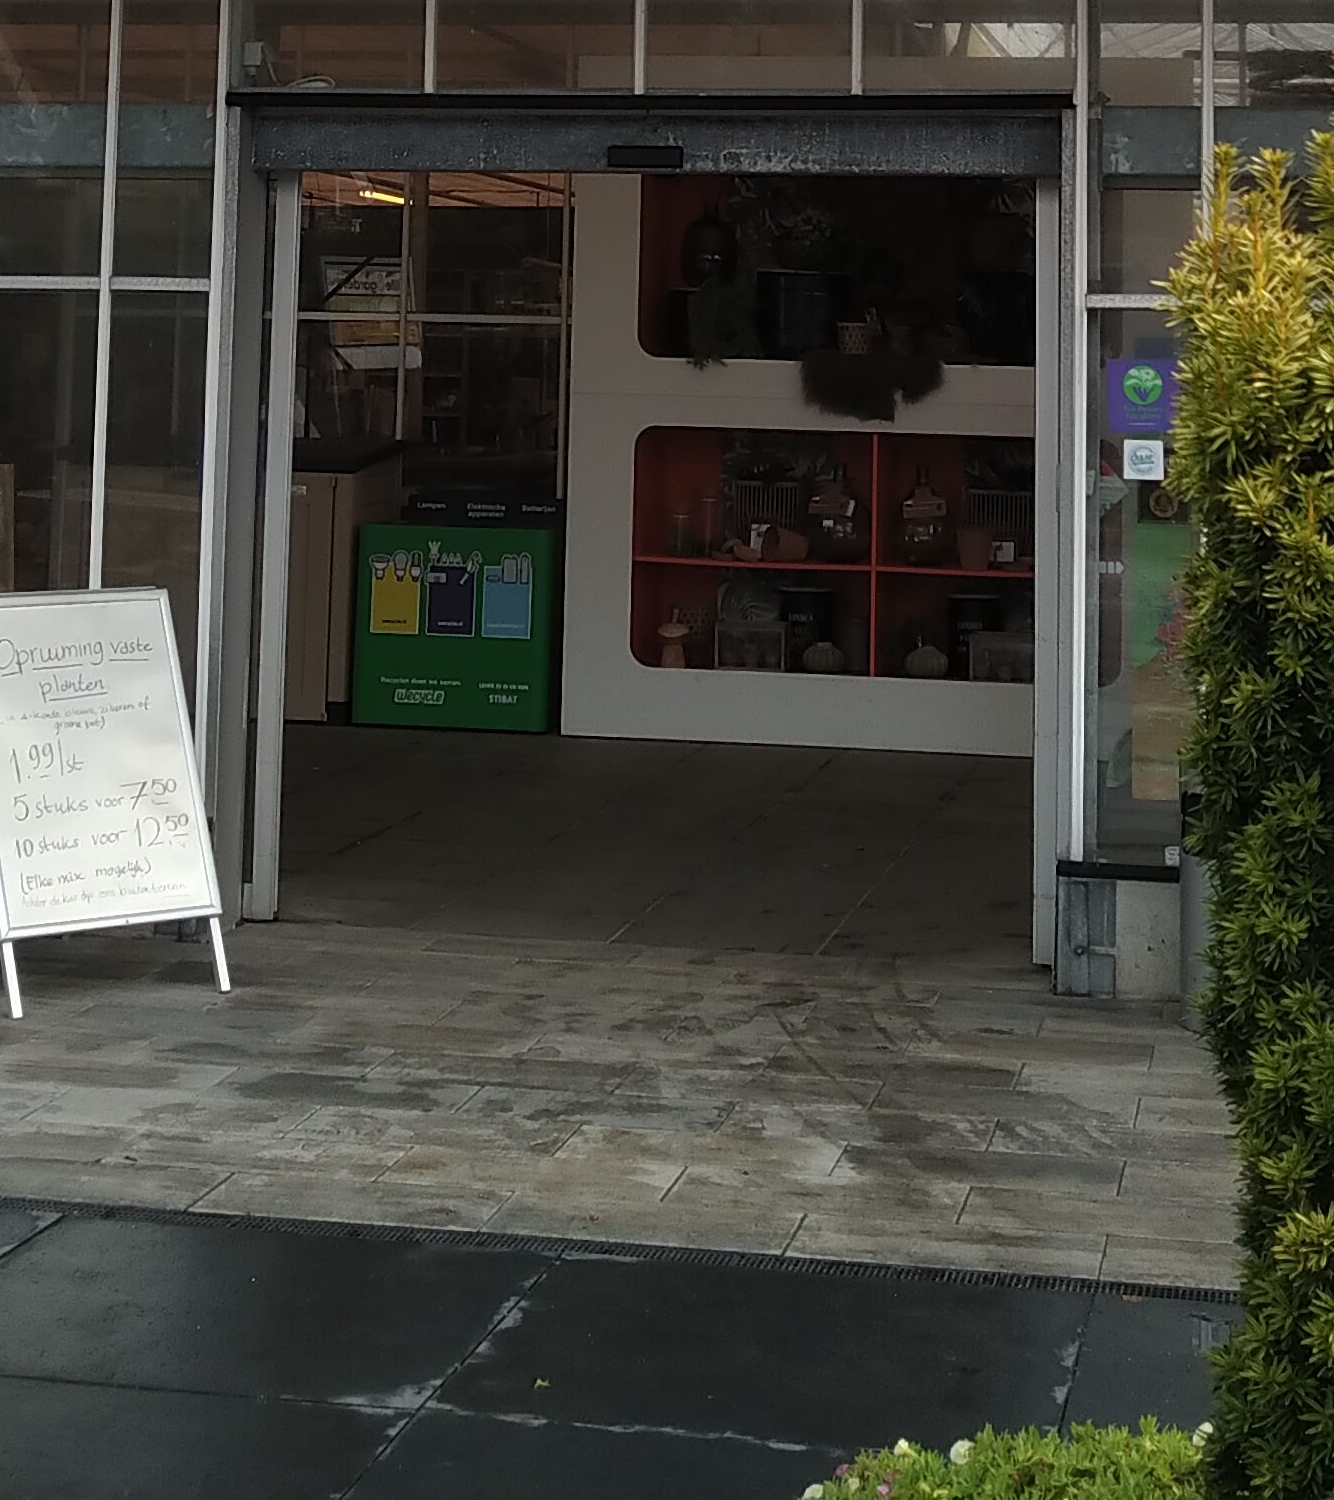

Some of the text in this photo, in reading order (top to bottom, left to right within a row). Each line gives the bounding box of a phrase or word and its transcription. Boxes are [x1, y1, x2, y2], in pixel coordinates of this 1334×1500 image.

[417, 501, 447, 510] Lampen
[109, 637, 154, 655] vaste
[39, 674, 106, 702] planten
[137, 695, 150, 711] of
[13, 793, 29, 822] 5
[35, 794, 89, 820] stuks
[95, 796, 125, 809] voor
[14, 838, 35, 860] 10
[38, 835, 79, 855] stuks
[91, 830, 128, 847] voor
[20, 871, 54, 895] (Elke
[58, 871, 86, 885] mix
